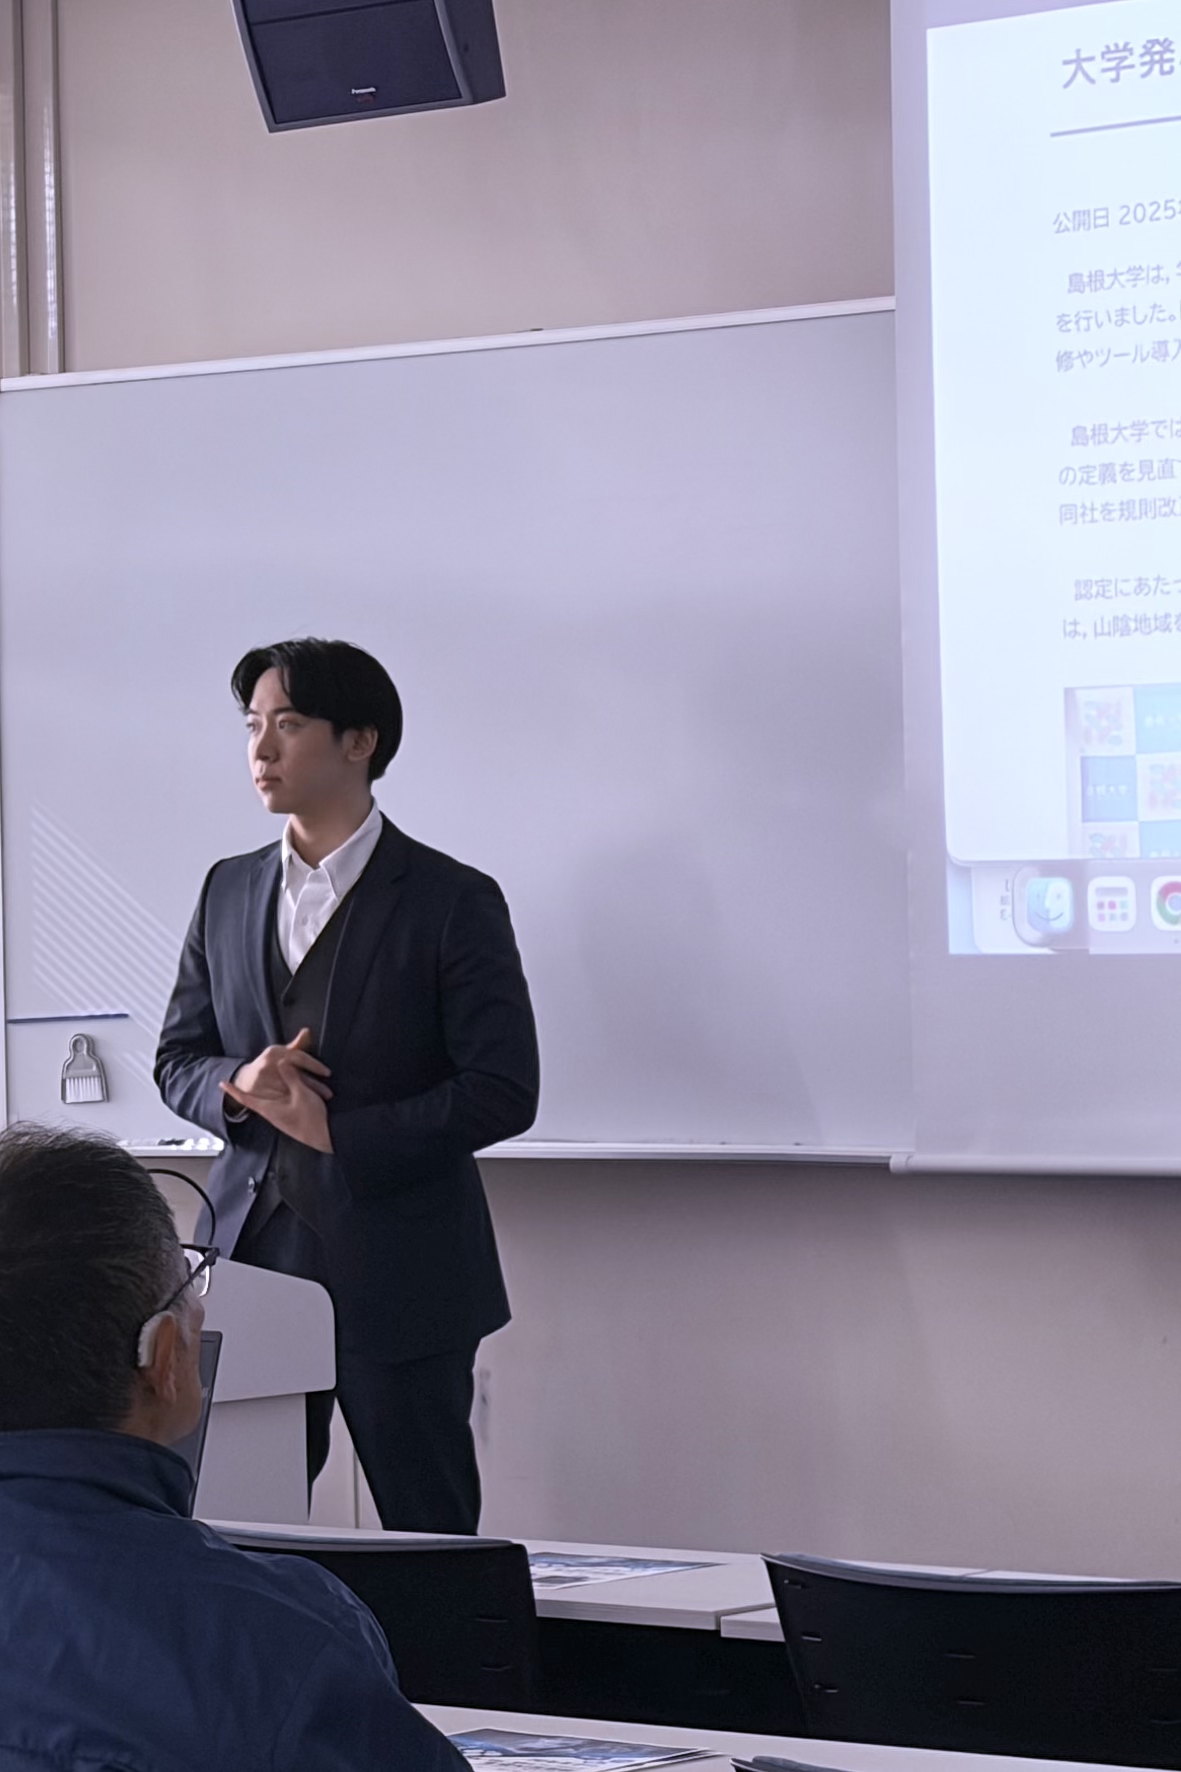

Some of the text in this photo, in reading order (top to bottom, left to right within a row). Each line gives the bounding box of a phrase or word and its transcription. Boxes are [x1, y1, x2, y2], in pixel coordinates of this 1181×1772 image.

[1062, 37, 1181, 89] 大学発
[1053, 198, 1181, 234] 公開日 2025
[1056, 300, 1181, 333] を行いました。
[1059, 457, 1181, 487] の定義を見直
[1059, 495, 1181, 526] 同社を規則改
